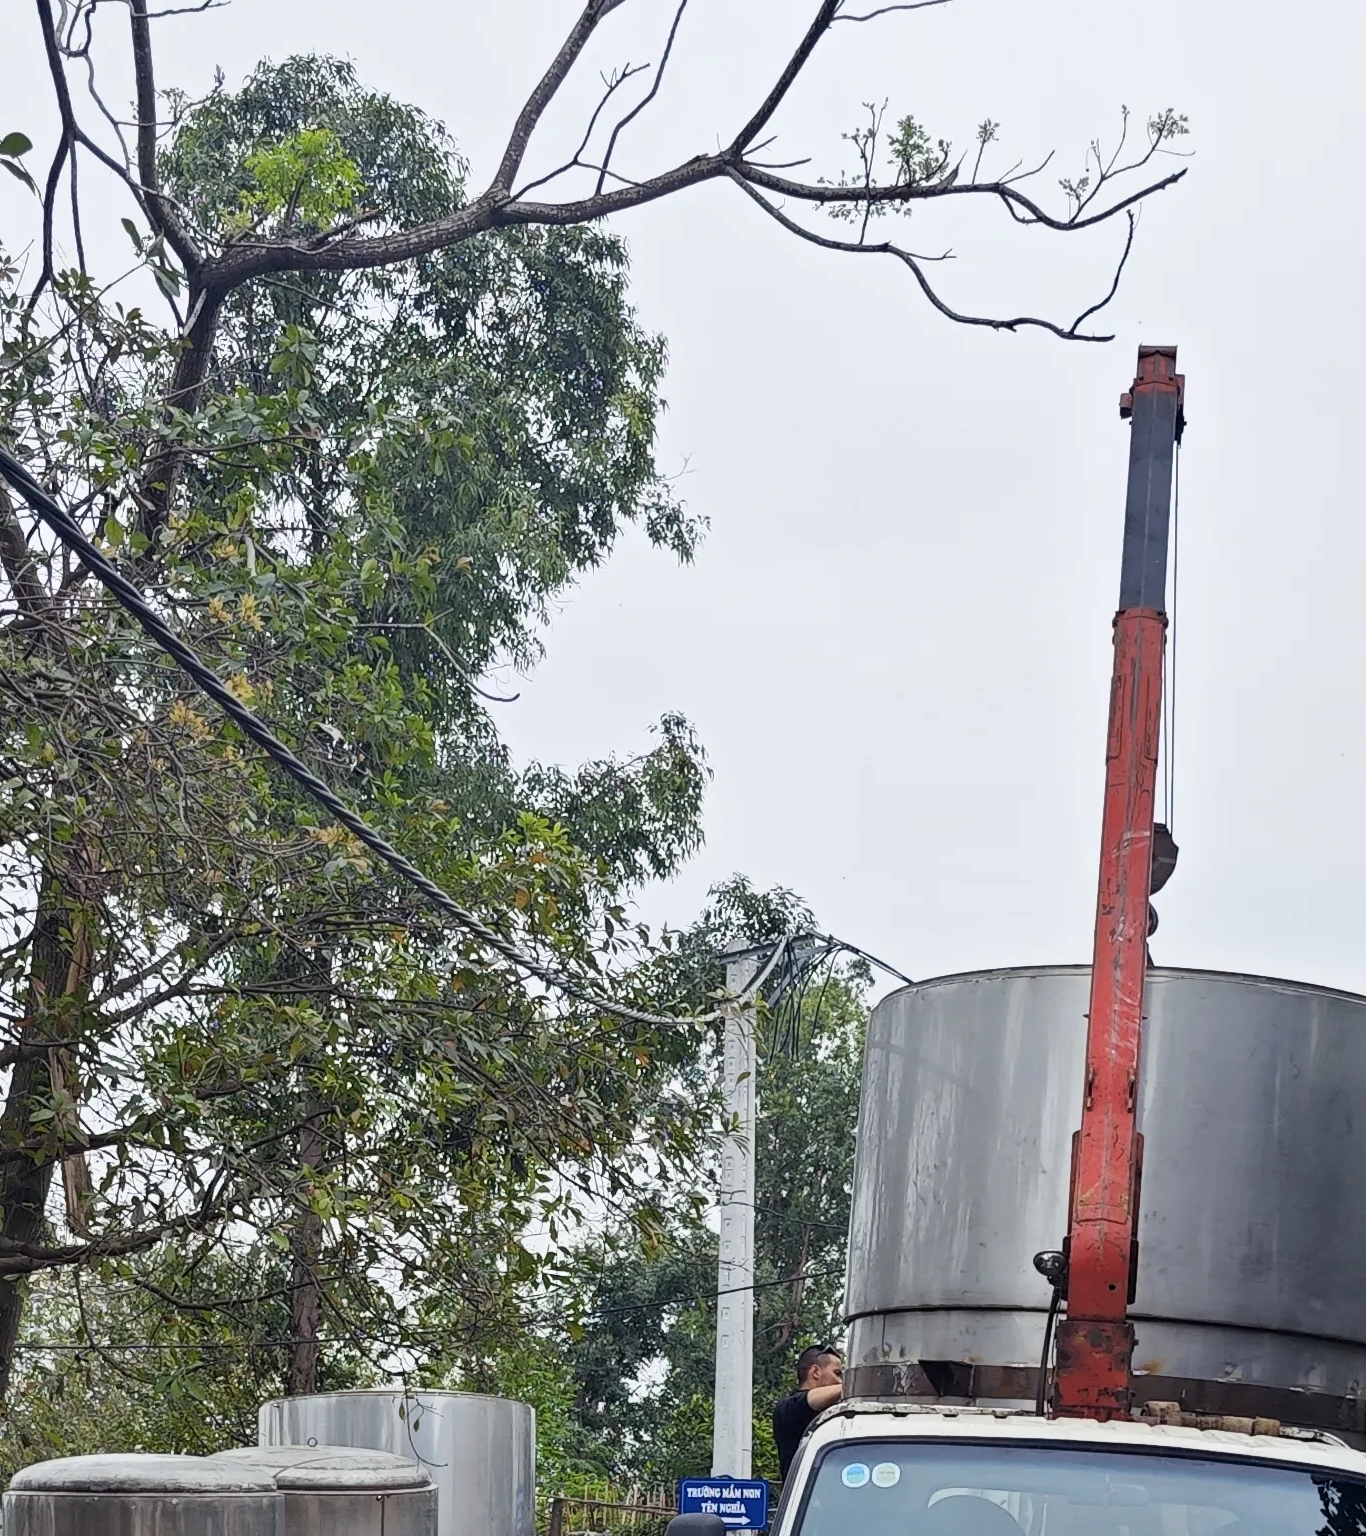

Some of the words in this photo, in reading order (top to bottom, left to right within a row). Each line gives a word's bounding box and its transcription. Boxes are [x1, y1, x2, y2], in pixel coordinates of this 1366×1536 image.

[743, 1489, 761, 1498] NON
[701, 1500, 718, 1513] YÊN
[719, 1501, 746, 1513] NGHĨA
